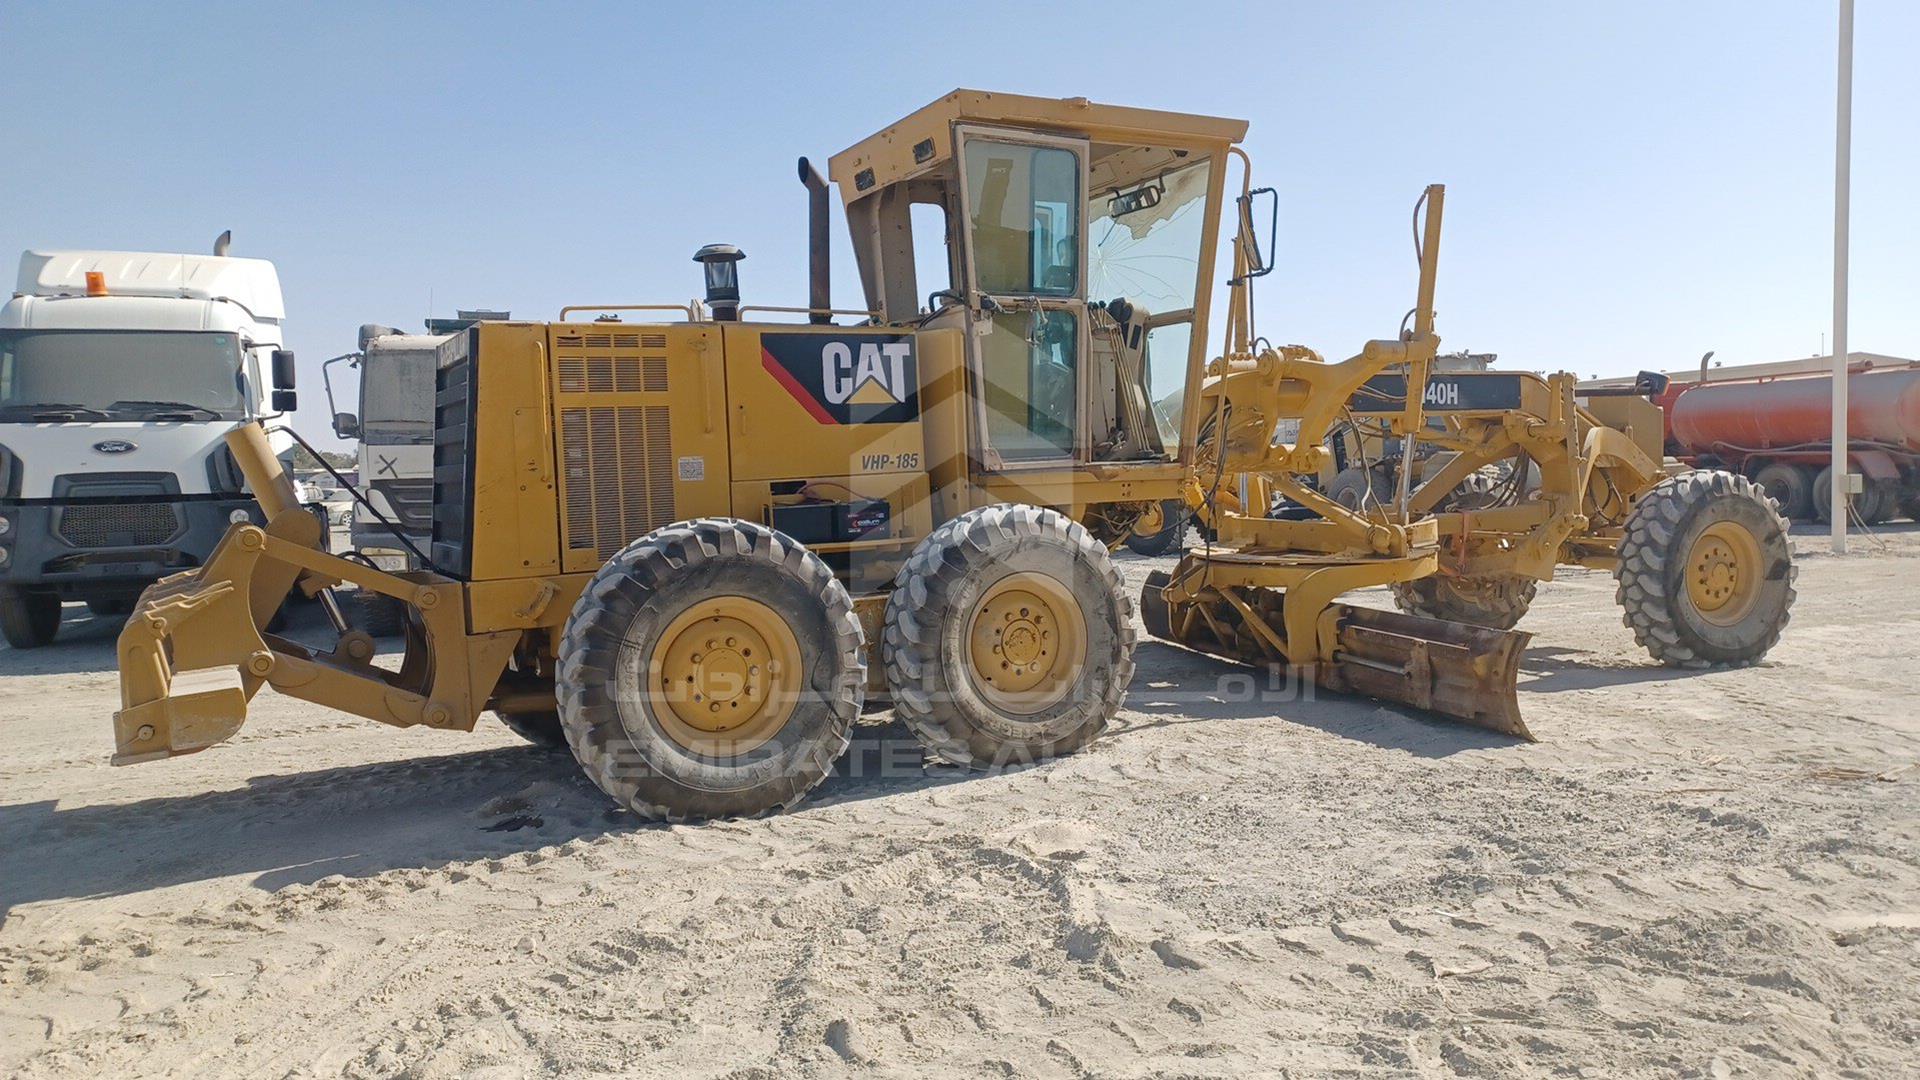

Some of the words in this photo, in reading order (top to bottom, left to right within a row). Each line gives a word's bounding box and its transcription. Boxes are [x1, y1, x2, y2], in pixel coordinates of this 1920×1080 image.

[821, 341, 911, 405] CAT
[1422, 382, 1459, 405] 40H
[861, 453, 919, 471] VHP-185
